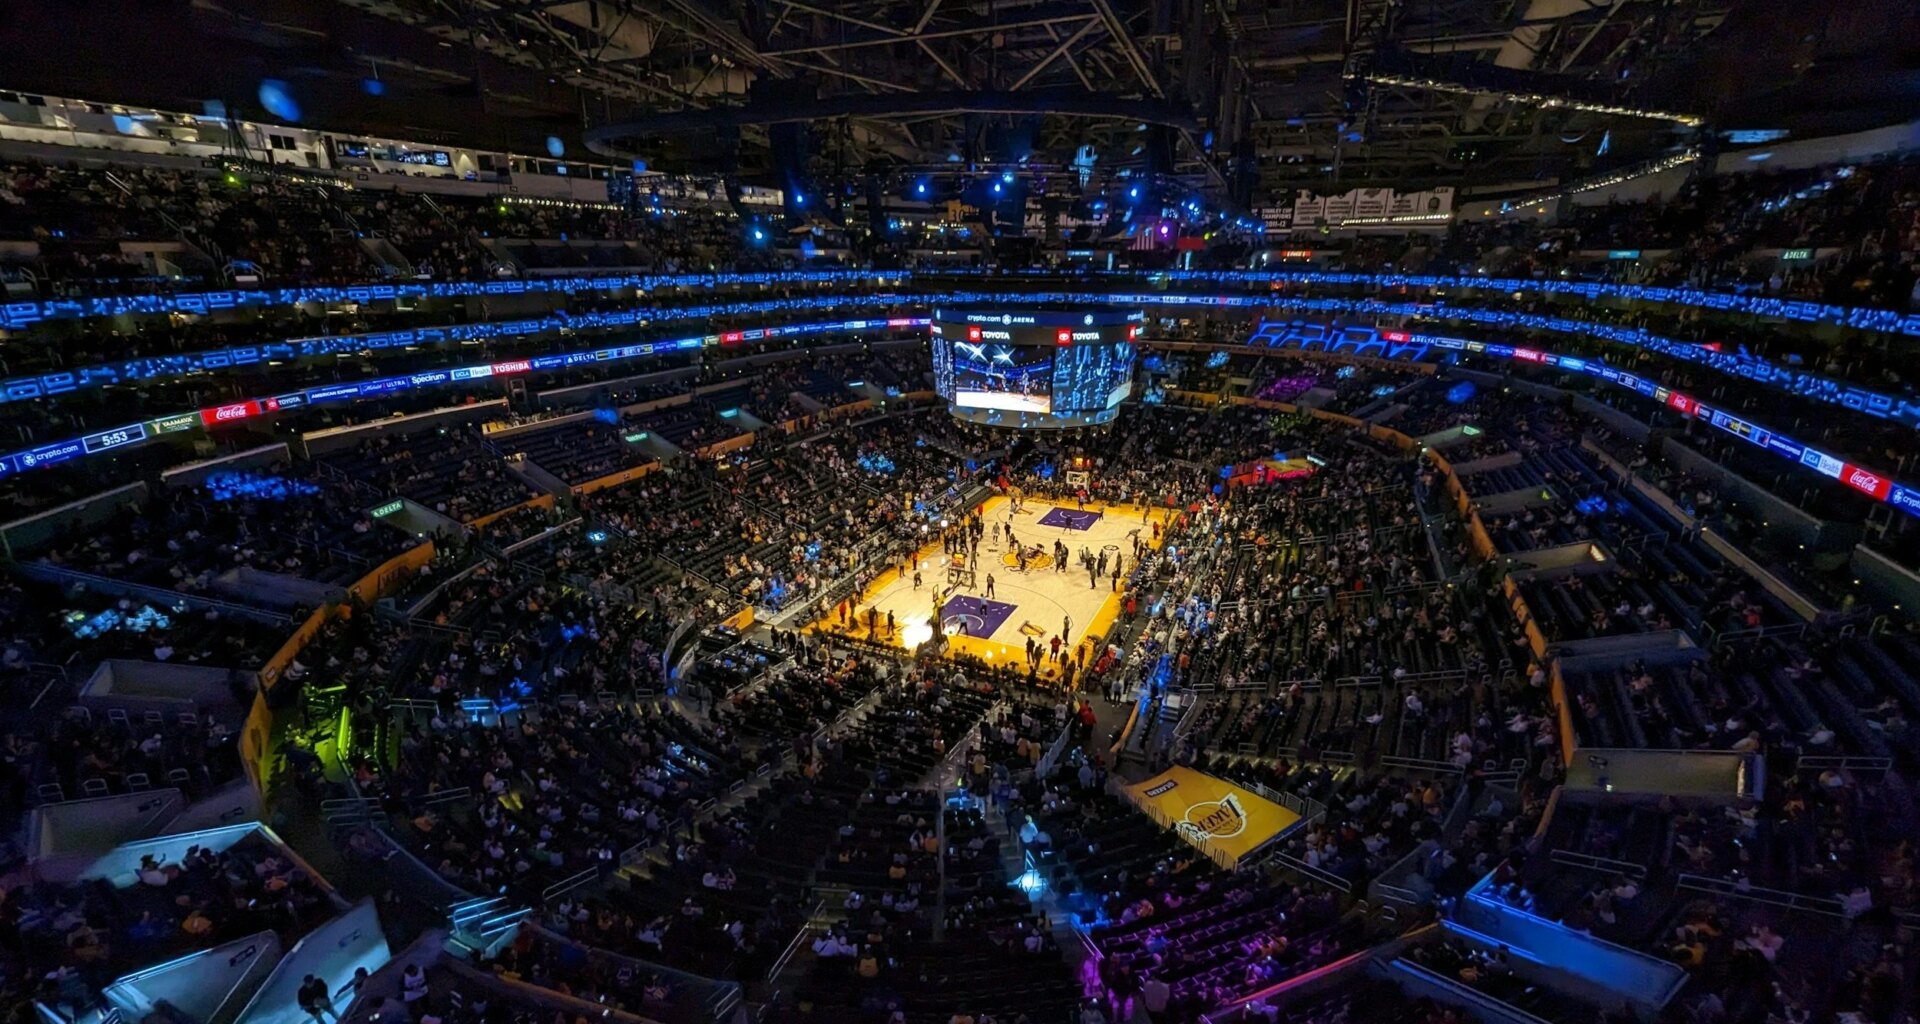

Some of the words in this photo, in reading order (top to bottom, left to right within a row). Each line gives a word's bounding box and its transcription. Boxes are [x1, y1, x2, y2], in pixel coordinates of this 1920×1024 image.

[1789, 251, 1807, 259] DELTA
[967, 315, 1001, 324] crypto.com
[981, 331, 1010, 340] TOYOTA
[1072, 332, 1100, 341] TOYOTA
[574, 353, 595, 361] DELTA
[472, 367, 491, 376] Health
[495, 361, 529, 373] TOSHIBA
[411, 373, 445, 385] Spectrum
[386, 380, 406, 388] ULTRA
[311, 390, 336, 399] AMERICAN
[278, 396, 301, 406] TOYOTA
[216, 405, 246, 421] Coca-Cola
[102, 431, 129, 446] 5:53
[36, 445, 79, 460] crypto.com
[1849, 469, 1880, 493] Coca-Cola
[380, 502, 401, 515] DELTA
